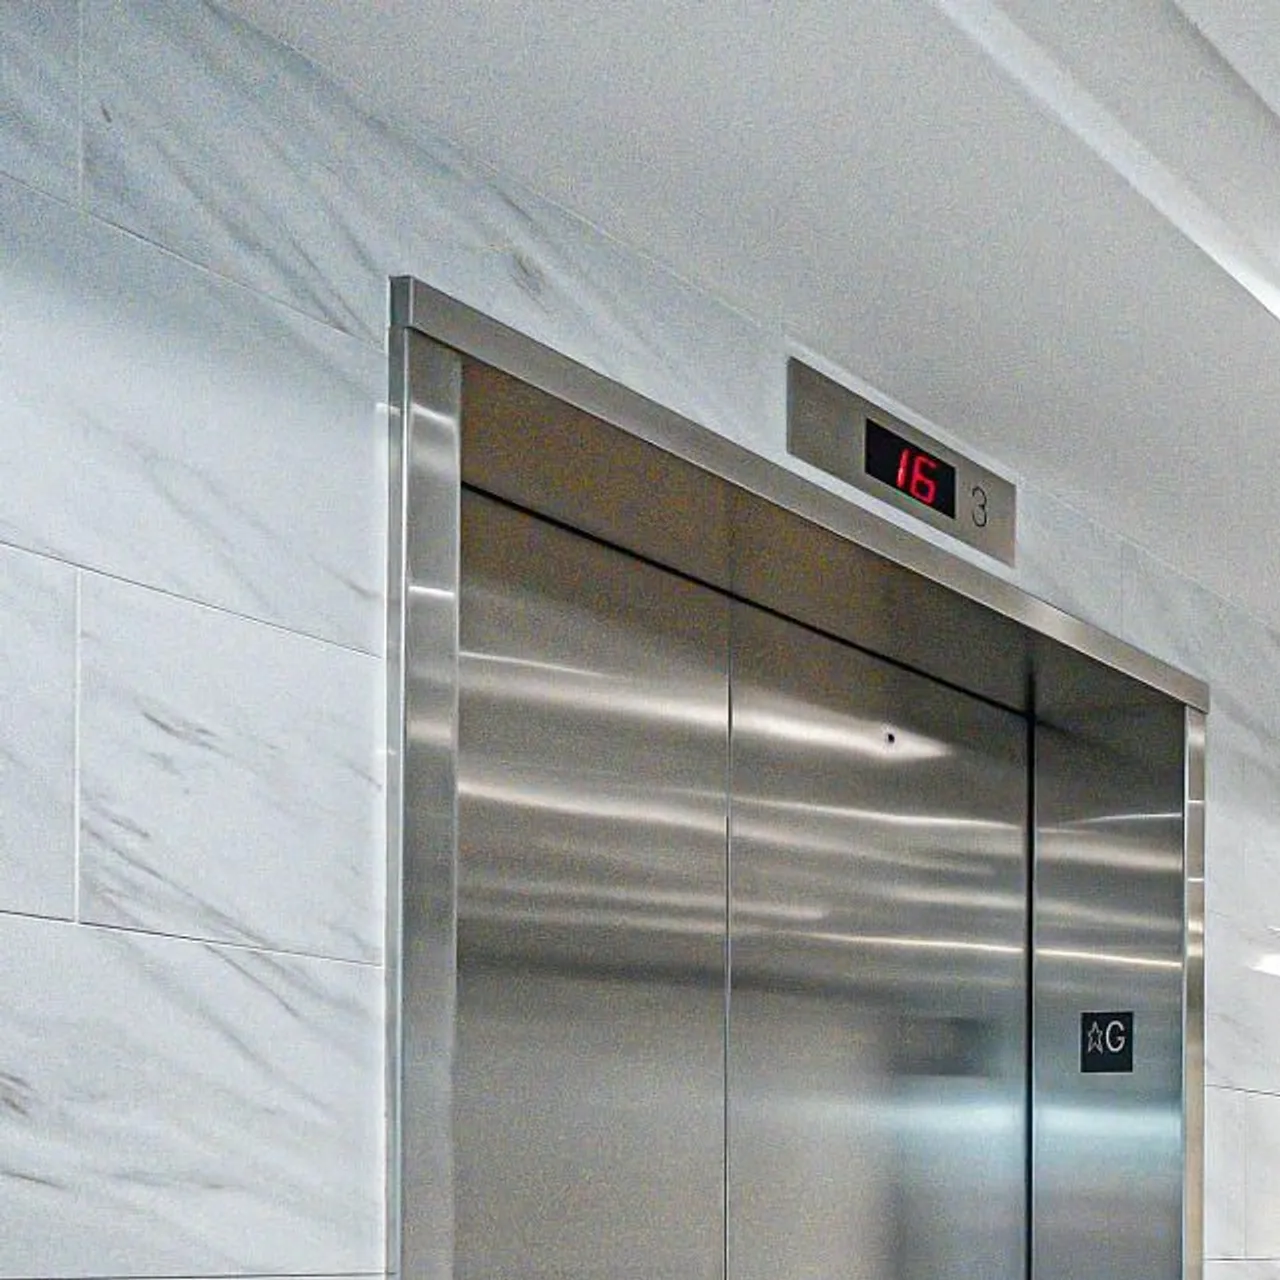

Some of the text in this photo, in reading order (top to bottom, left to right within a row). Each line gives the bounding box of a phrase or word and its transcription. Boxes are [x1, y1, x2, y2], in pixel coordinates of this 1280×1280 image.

[896, 446, 939, 505] 16
[971, 485, 988, 528] 3
[1105, 1020, 1126, 1053] G
